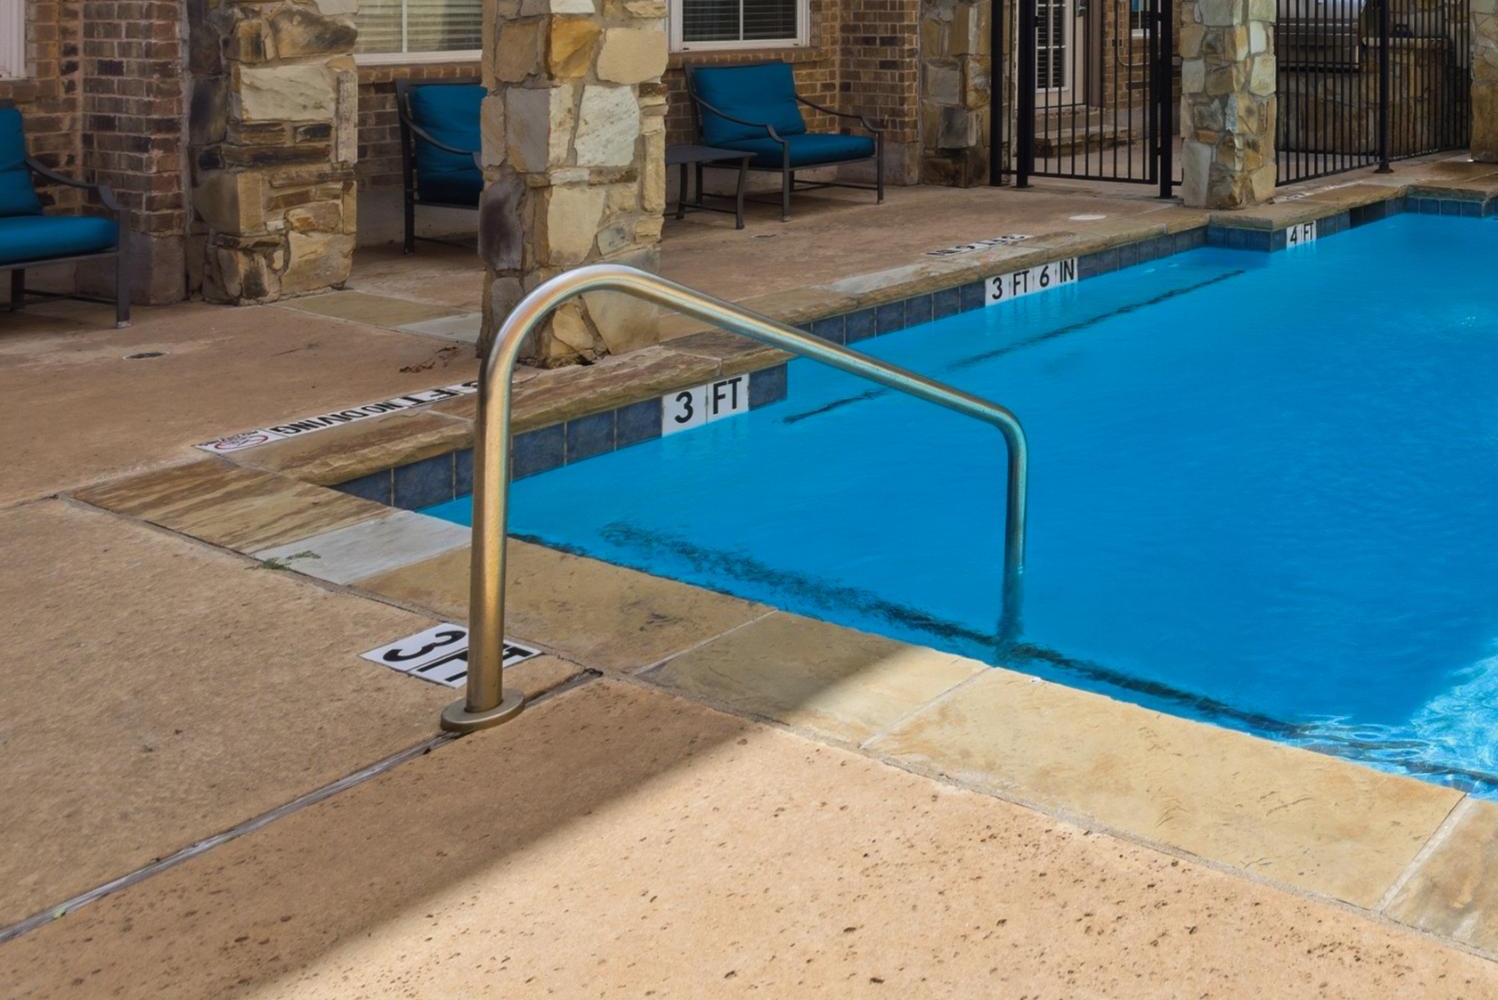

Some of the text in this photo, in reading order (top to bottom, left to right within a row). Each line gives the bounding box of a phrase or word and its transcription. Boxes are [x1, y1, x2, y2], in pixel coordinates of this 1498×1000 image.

[1290, 221, 1315, 245] 4 FT
[991, 258, 1075, 300] 3 FT 6 IN
[361, 400, 404, 415] NO
[674, 376, 743, 424] 3 FT
[270, 410, 369, 435] DIVING
[382, 630, 467, 662] 3
